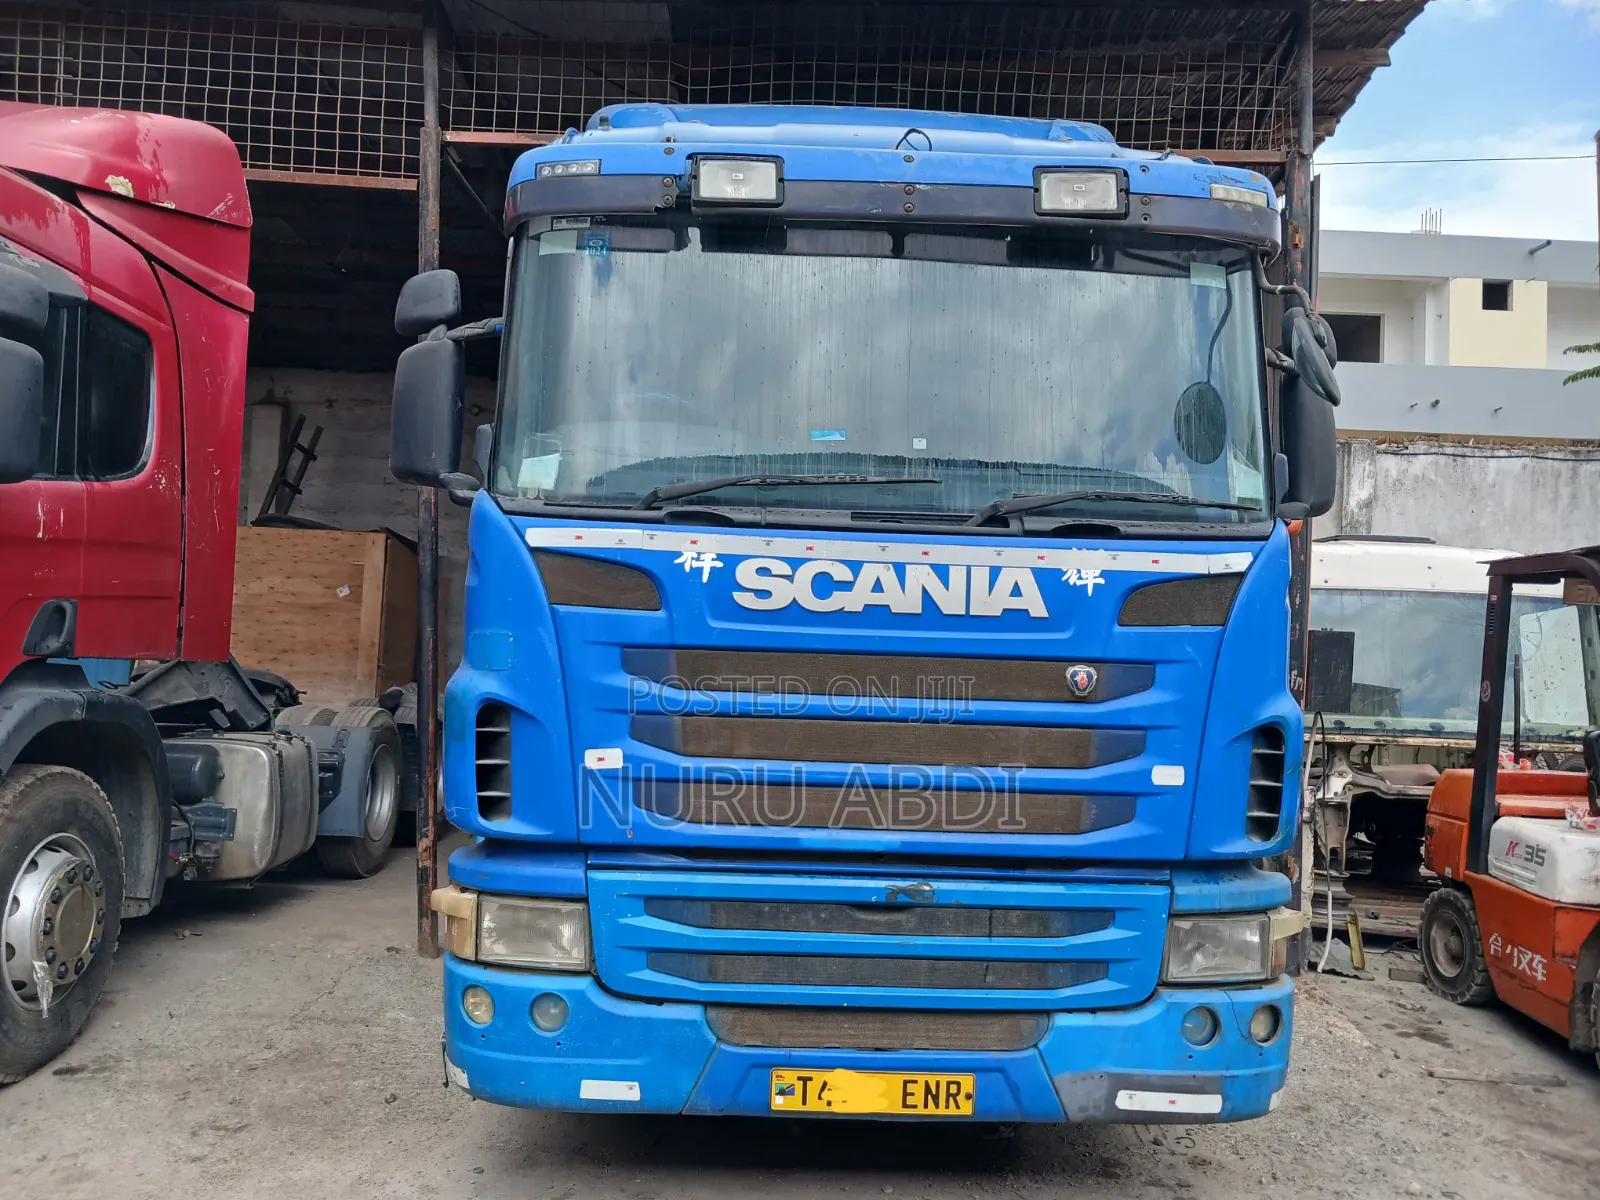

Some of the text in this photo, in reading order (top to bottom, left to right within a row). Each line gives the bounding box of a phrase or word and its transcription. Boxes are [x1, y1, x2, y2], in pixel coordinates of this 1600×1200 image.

[584, 246, 607, 257] 2024
[732, 557, 1049, 618] SCANIA
[901, 1079, 961, 1110] ENR
